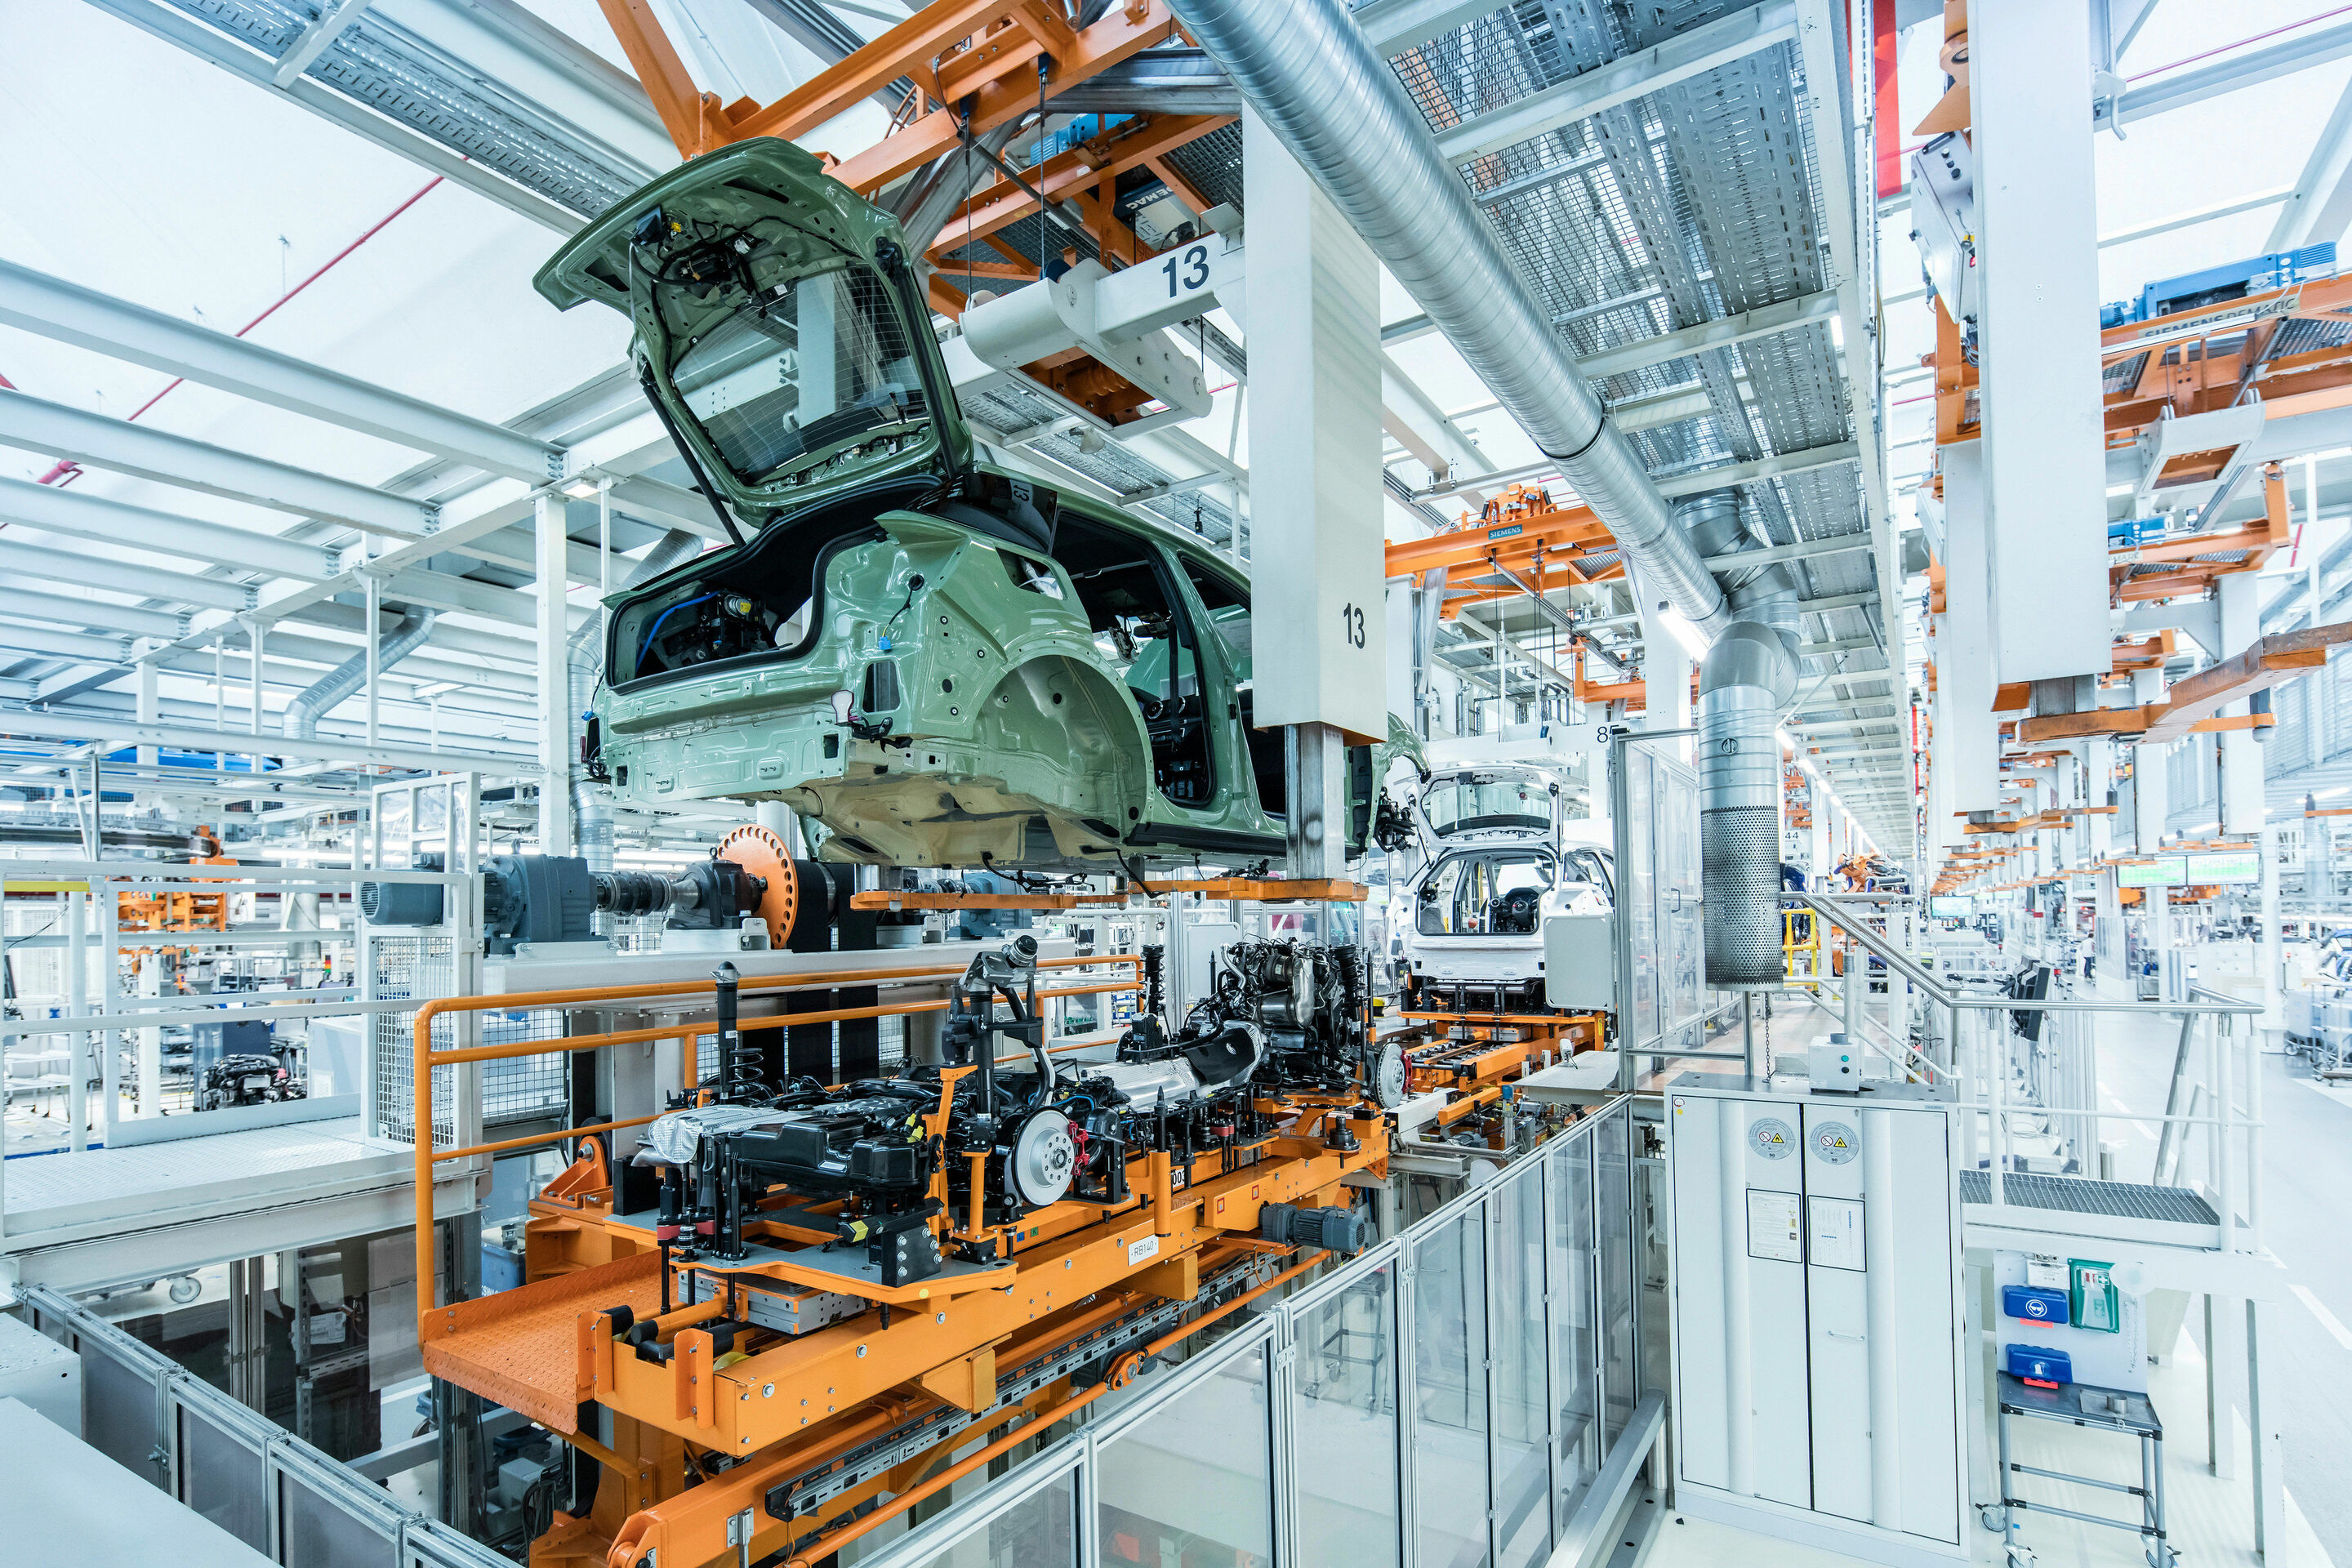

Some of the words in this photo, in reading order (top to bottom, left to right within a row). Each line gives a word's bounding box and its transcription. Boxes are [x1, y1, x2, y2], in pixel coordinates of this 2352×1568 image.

[1163, 246, 1209, 298] 13
[1490, 526, 1521, 538] SIEMENS
[1343, 602, 1365, 649] 13
